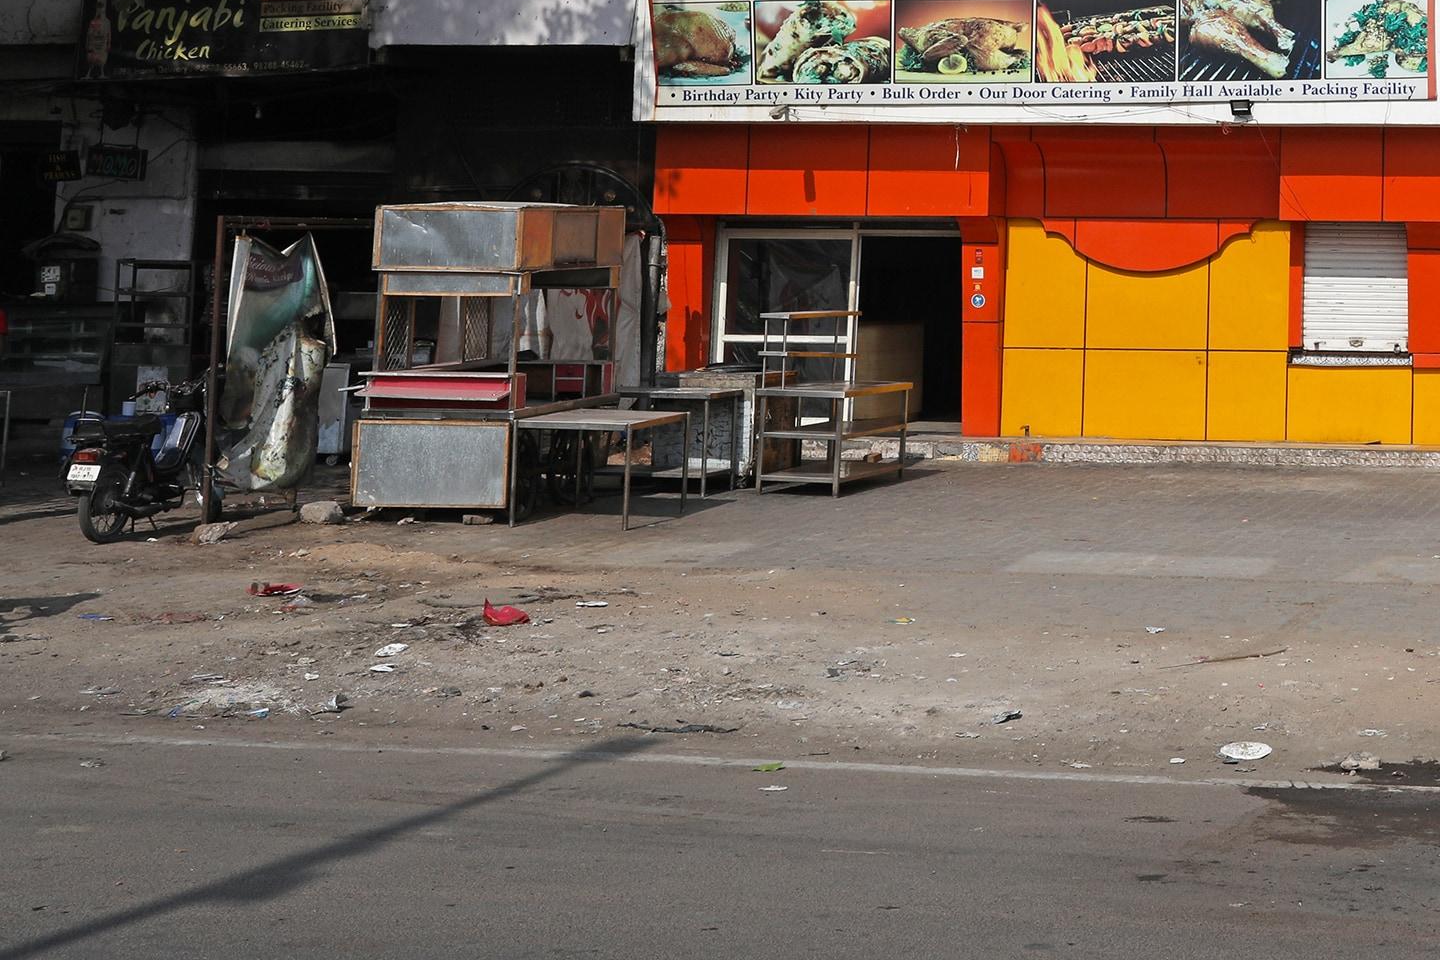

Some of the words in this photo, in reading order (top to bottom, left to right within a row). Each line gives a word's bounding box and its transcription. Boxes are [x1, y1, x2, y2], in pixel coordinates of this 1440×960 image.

[306, 1, 343, 14] Facility
[262, 18, 312, 31] Cattering
[314, 16, 358, 28] Services
[135, 40, 211, 61] Chicken
[682, 90, 740, 104] Birthday
[745, 89, 780, 104] Party
[794, 87, 823, 103] Kity
[828, 87, 863, 103] Party
[882, 86, 914, 100] Bulk
[918, 86, 960, 100] Order
[979, 86, 1008, 99] Our
[1013, 85, 1047, 99] Door
[1051, 86, 1111, 102] Catering
[1130, 85, 1177, 100] Family
[1183, 84, 1214, 98] Hall
[1218, 83, 1283, 97] Available
[1301, 83, 1359, 99] Packing
[1363, 82, 1417, 99] Facility
